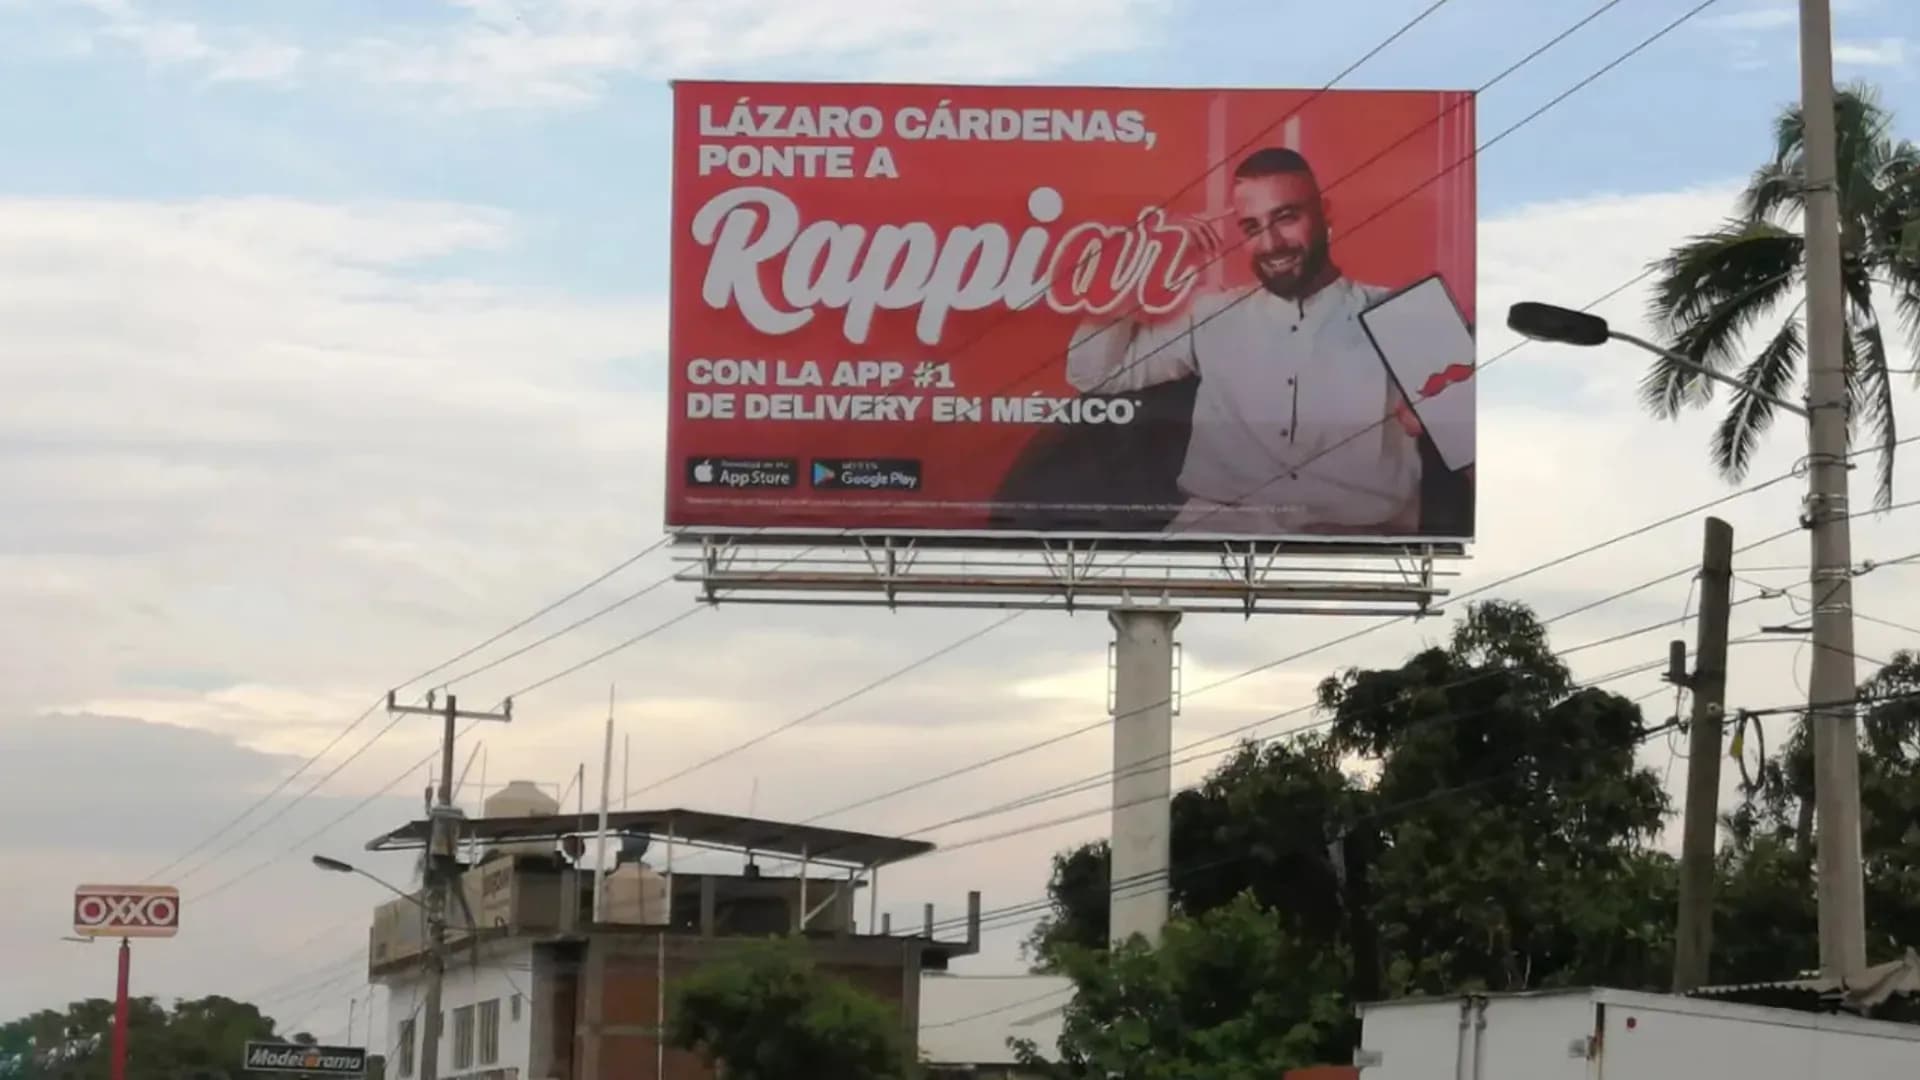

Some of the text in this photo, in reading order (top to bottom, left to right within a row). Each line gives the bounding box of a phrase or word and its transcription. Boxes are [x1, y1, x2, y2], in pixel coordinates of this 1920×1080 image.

[700, 97, 1156, 150] LÁZARO CÁRDENAS,
[699, 144, 899, 178] PONTE A
[692, 186, 1198, 345] Rappiar
[687, 358, 955, 389] CON LA APP #1
[687, 392, 735, 419] DE
[745, 393, 924, 421] DELIVERY
[932, 396, 982, 421] EN
[719, 469, 790, 487] App Store
[841, 471, 918, 489] Google Play
[79, 895, 176, 926] OXXO
